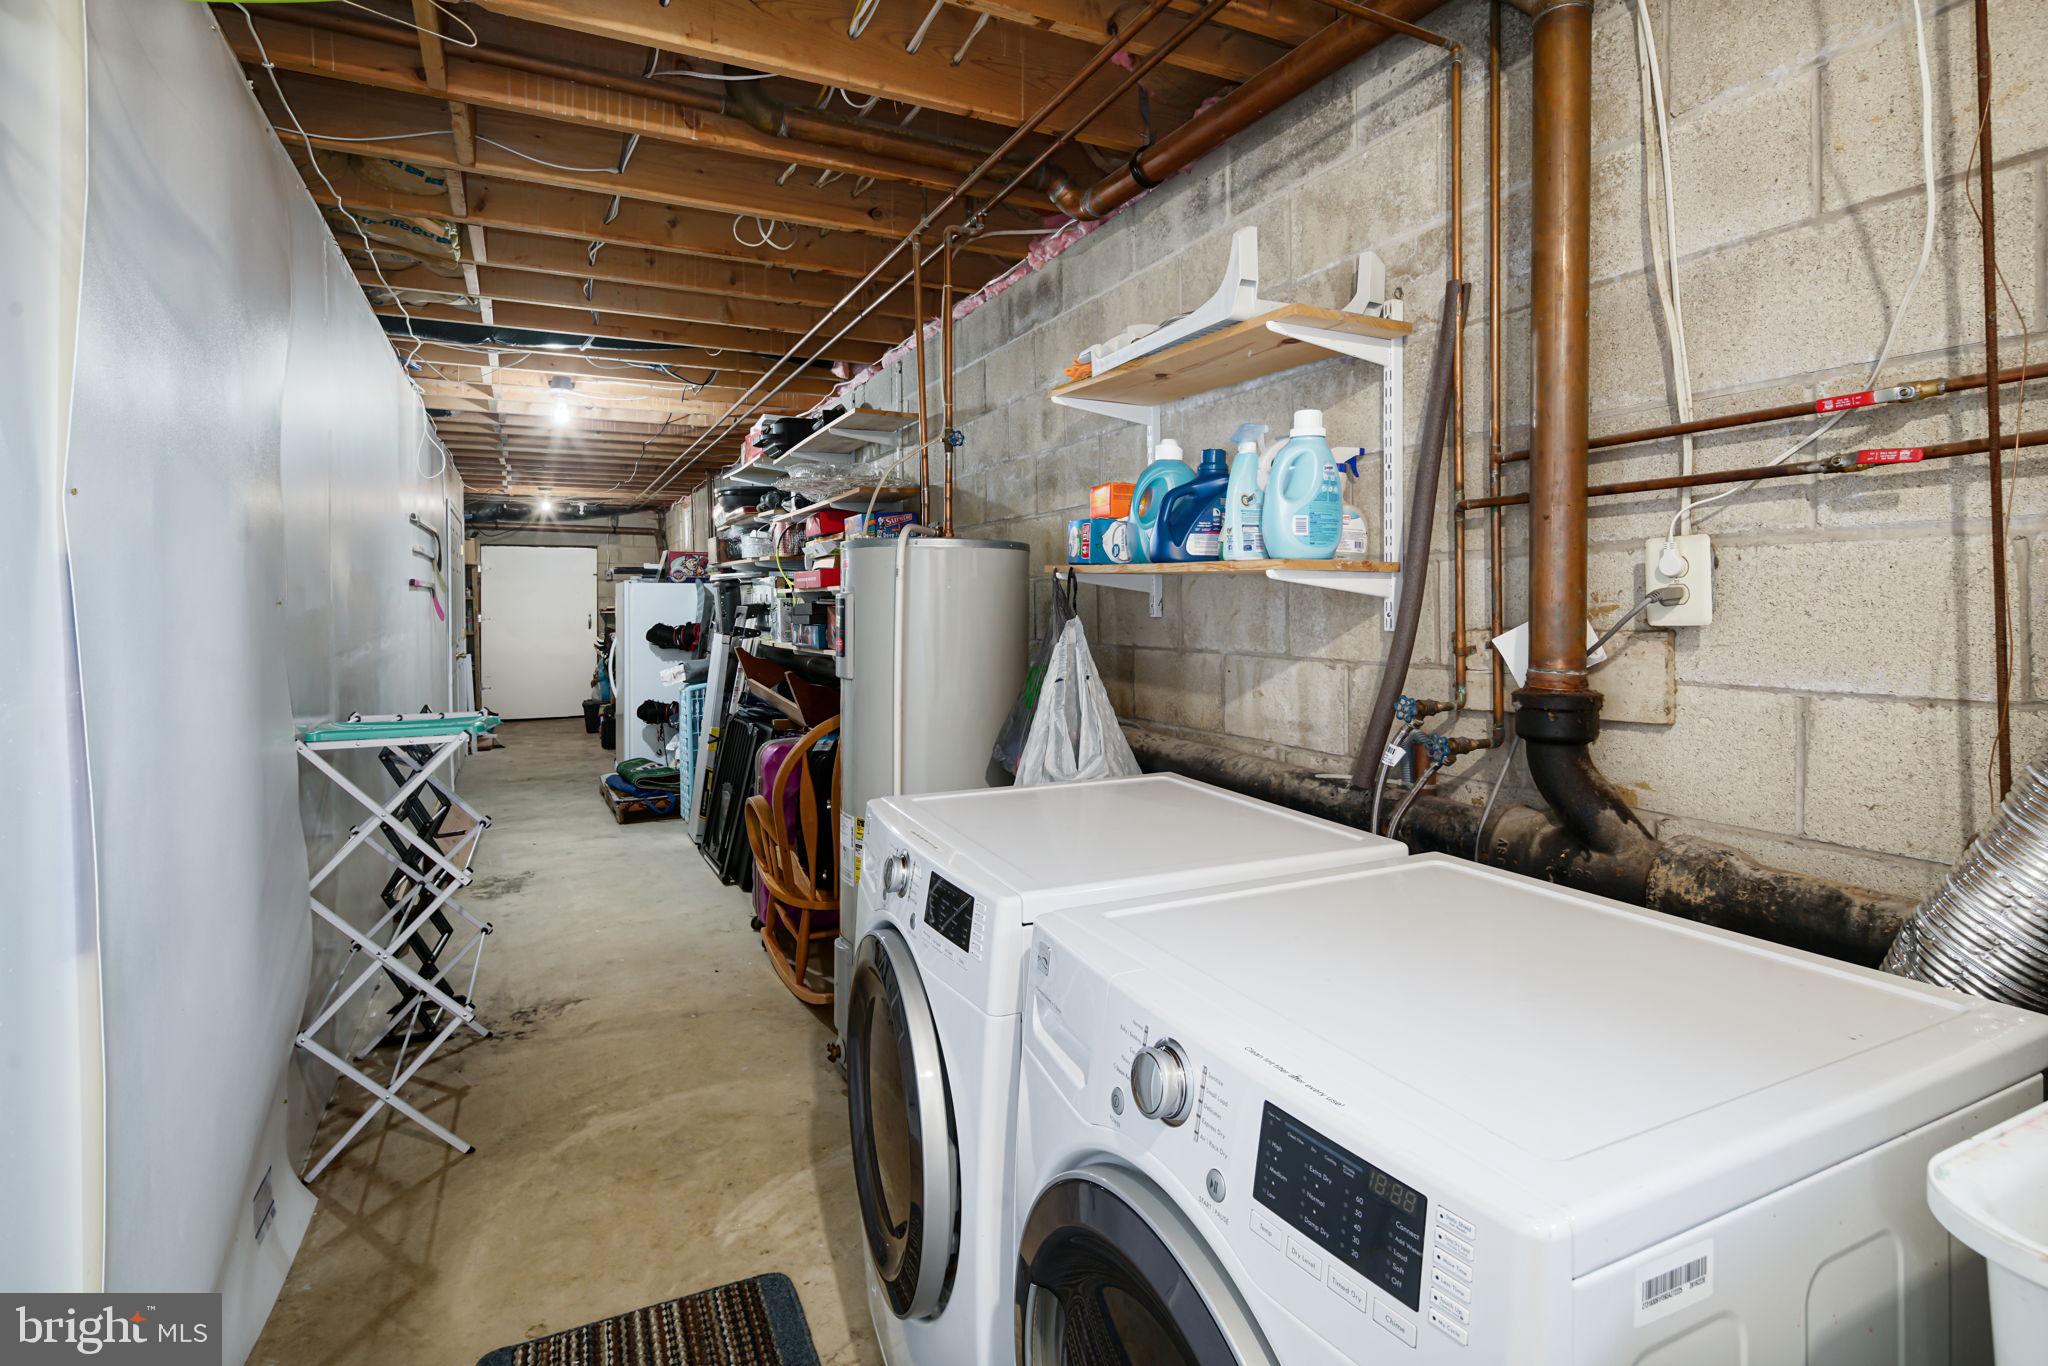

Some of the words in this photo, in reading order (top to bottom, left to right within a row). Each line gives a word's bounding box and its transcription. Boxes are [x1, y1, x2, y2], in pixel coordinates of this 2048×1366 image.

[1269, 1166, 1288, 1182] Medium
[1309, 1164, 1323, 1178] Extra
[1322, 1172, 1333, 1184] Dry
[1306, 1191, 1326, 1208] Normal
[1355, 1195, 1365, 1206] 60
[1354, 1208, 1364, 1219] 50
[1304, 1216, 1320, 1231] Damp
[1319, 1226, 1330, 1239] Dry
[1353, 1223, 1362, 1233] 40
[1351, 1236, 1361, 1246] 30
[1291, 1248, 1302, 1261] Dry
[1301, 1254, 1316, 1270] Level
[1350, 1249, 1359, 1259] 20
[1393, 1248, 1408, 1263] Loud
[1392, 1262, 1405, 1276] Soft
[1332, 1276, 1351, 1295] Timed
[1350, 1289, 1363, 1304] Dry
[1391, 1277, 1403, 1288] Off
[1384, 1314, 1406, 1334] Chime
